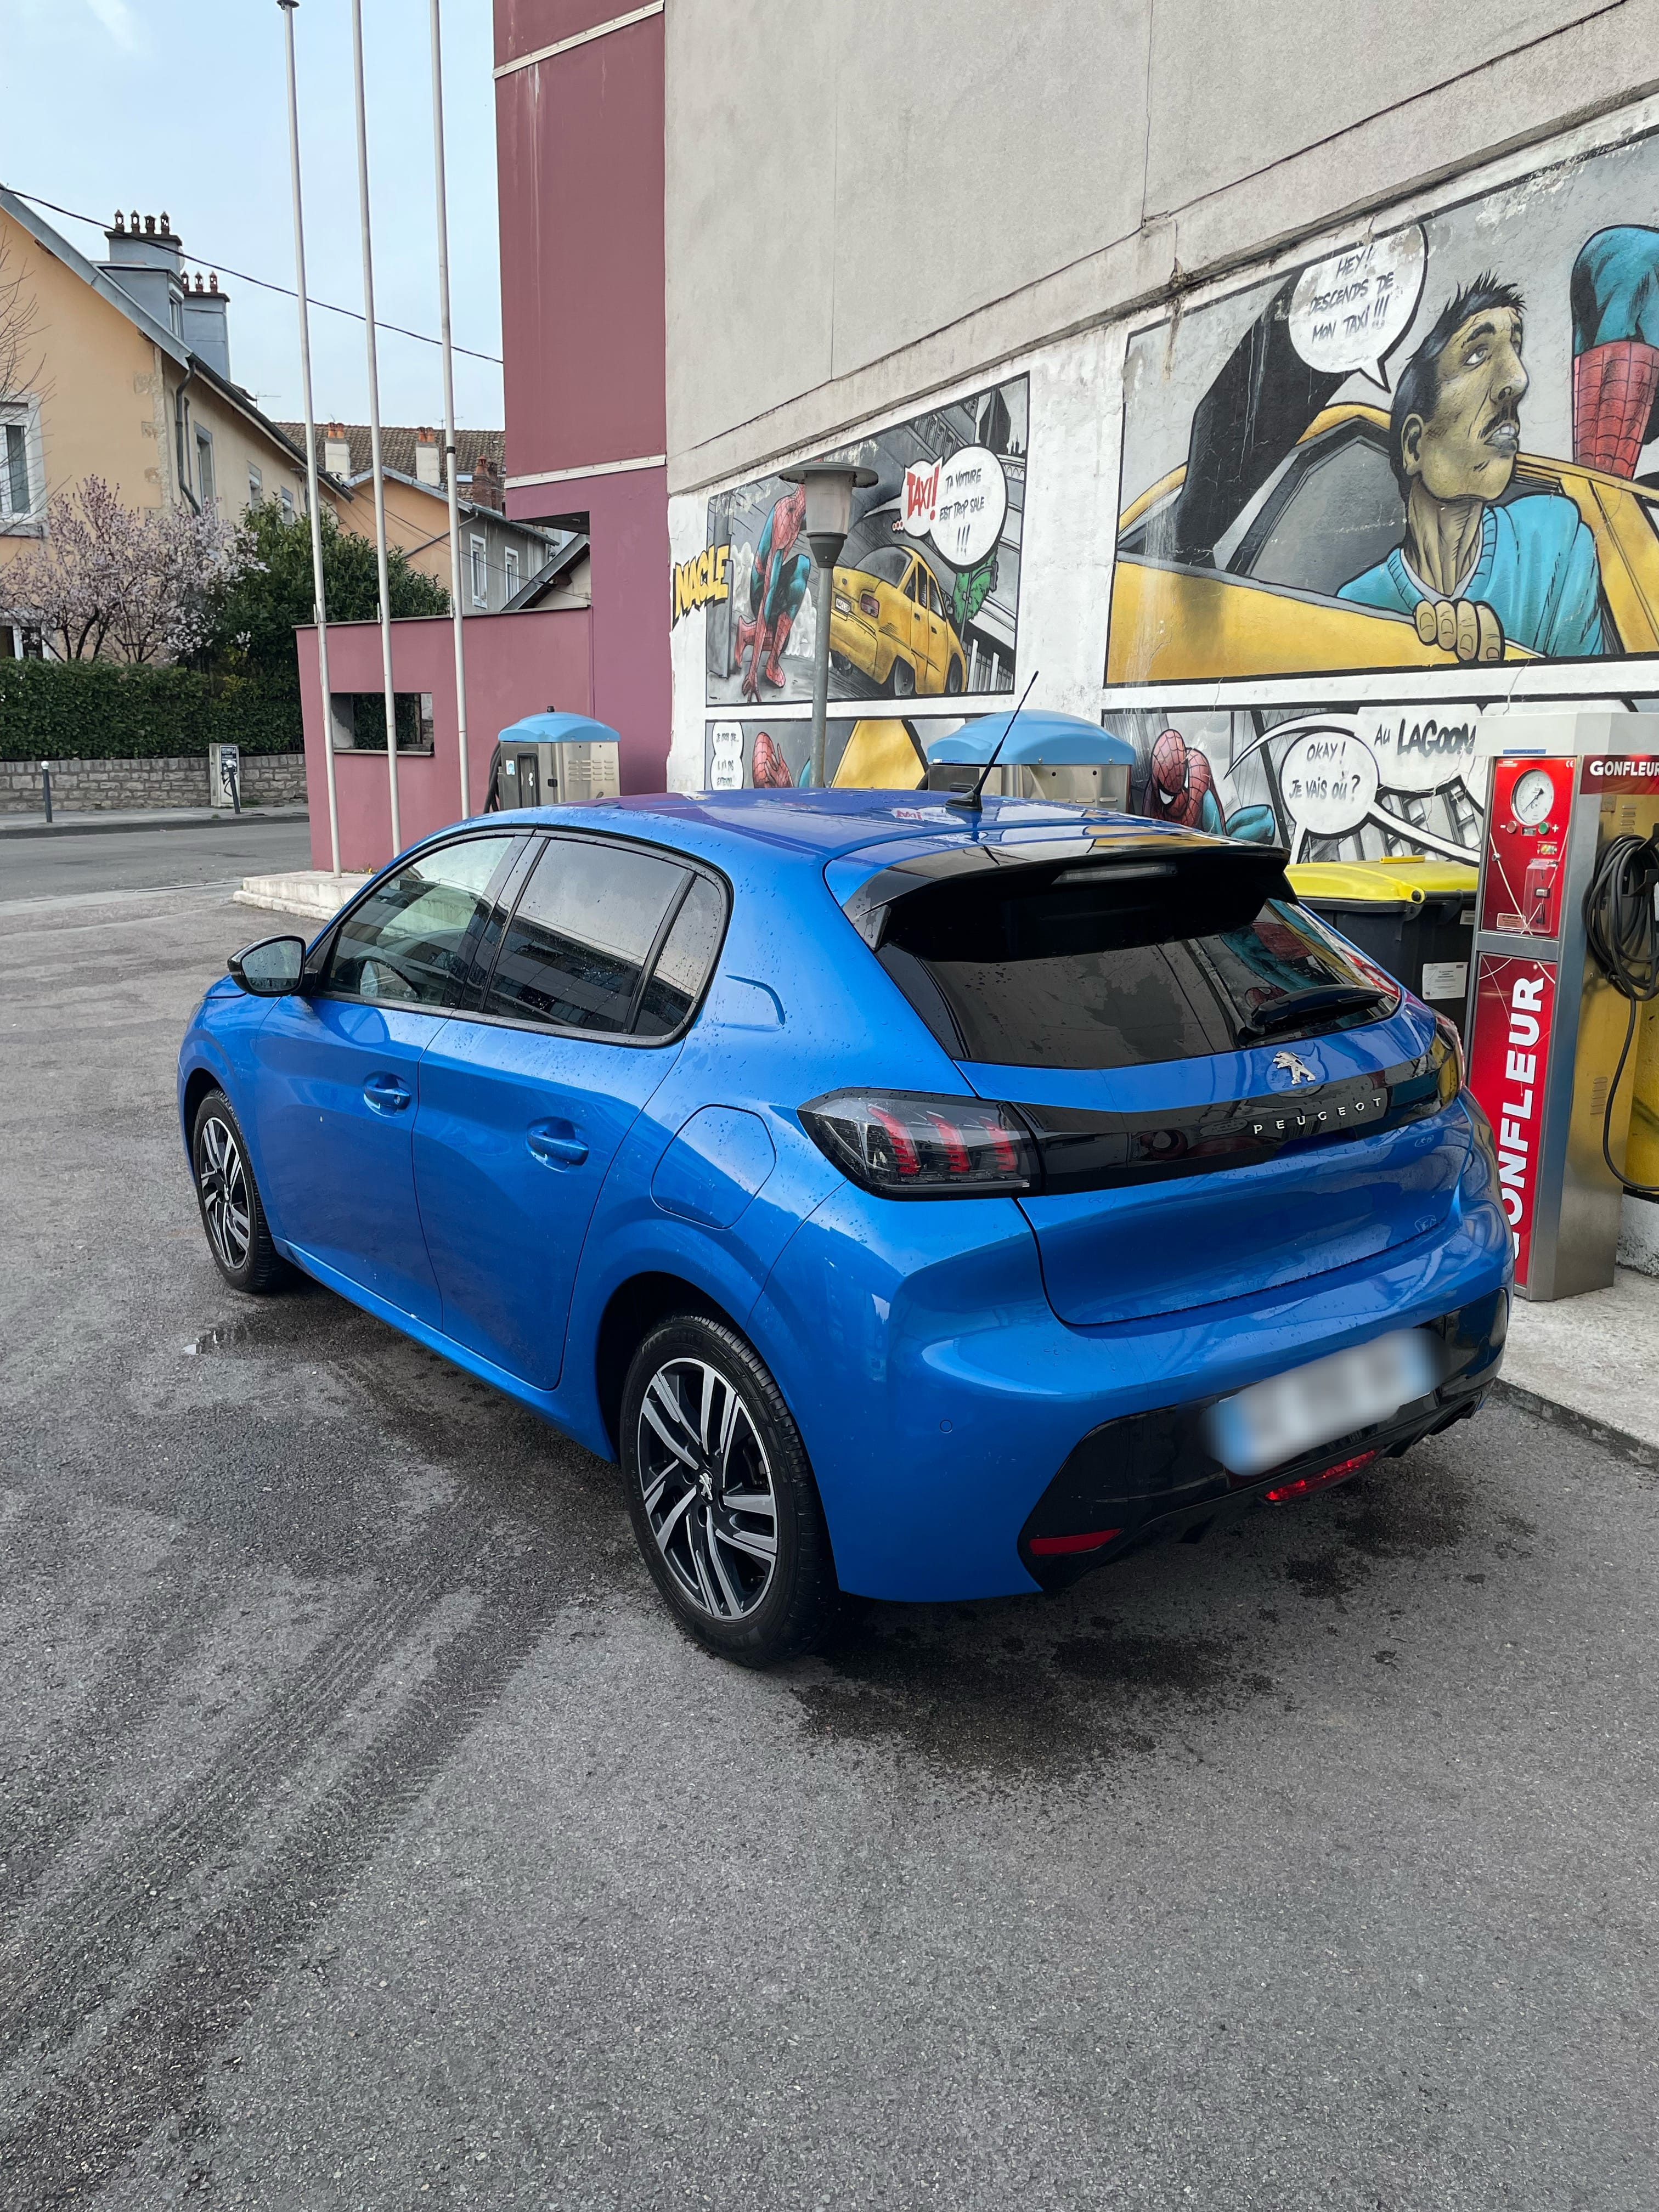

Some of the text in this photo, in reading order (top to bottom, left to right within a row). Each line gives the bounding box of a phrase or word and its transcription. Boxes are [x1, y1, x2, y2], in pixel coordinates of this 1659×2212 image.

[1308, 272, 1394, 317] DESCENDS DE
[1312, 320, 1337, 344] MON
[946, 468, 981, 494] TA VOITURE
[953, 499, 968, 520] TROP
[970, 496, 984, 513] SALE
[674, 543, 730, 622] NACLE
[1397, 718, 1477, 758] LAGOON
[1289, 780, 1302, 799] JE
[1253, 1097, 1381, 1135] PEUGEOT
[1498, 978, 1544, 1260] ONFLEUR
